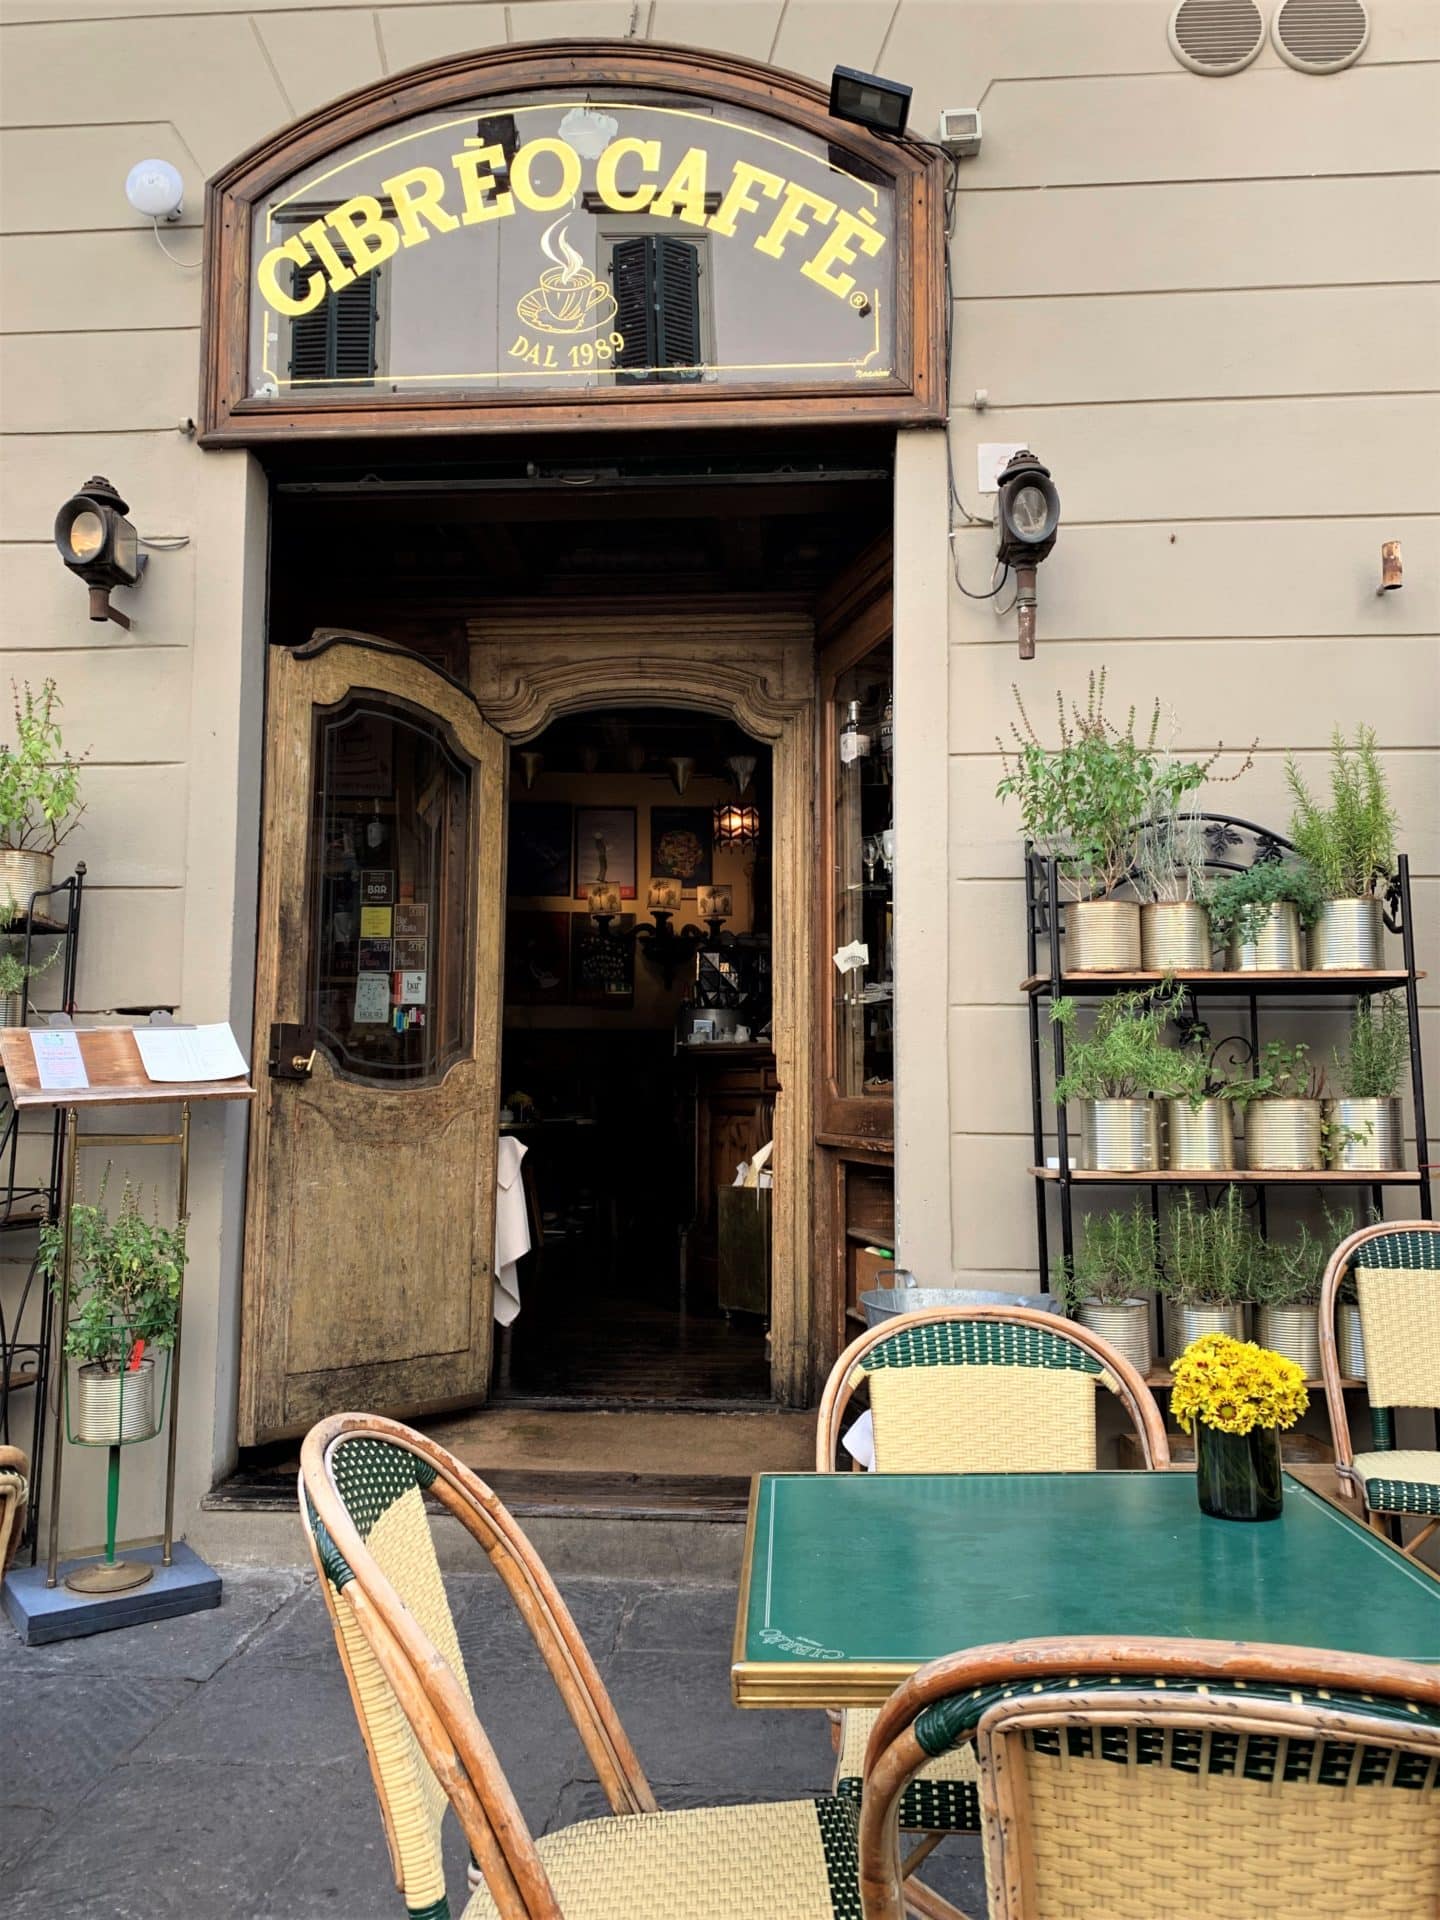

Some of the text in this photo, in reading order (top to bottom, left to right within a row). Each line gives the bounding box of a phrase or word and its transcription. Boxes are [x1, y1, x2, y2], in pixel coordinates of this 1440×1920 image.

[595, 136, 887, 300] CAFFÈ
[507, 332, 625, 368] DAL 1989
